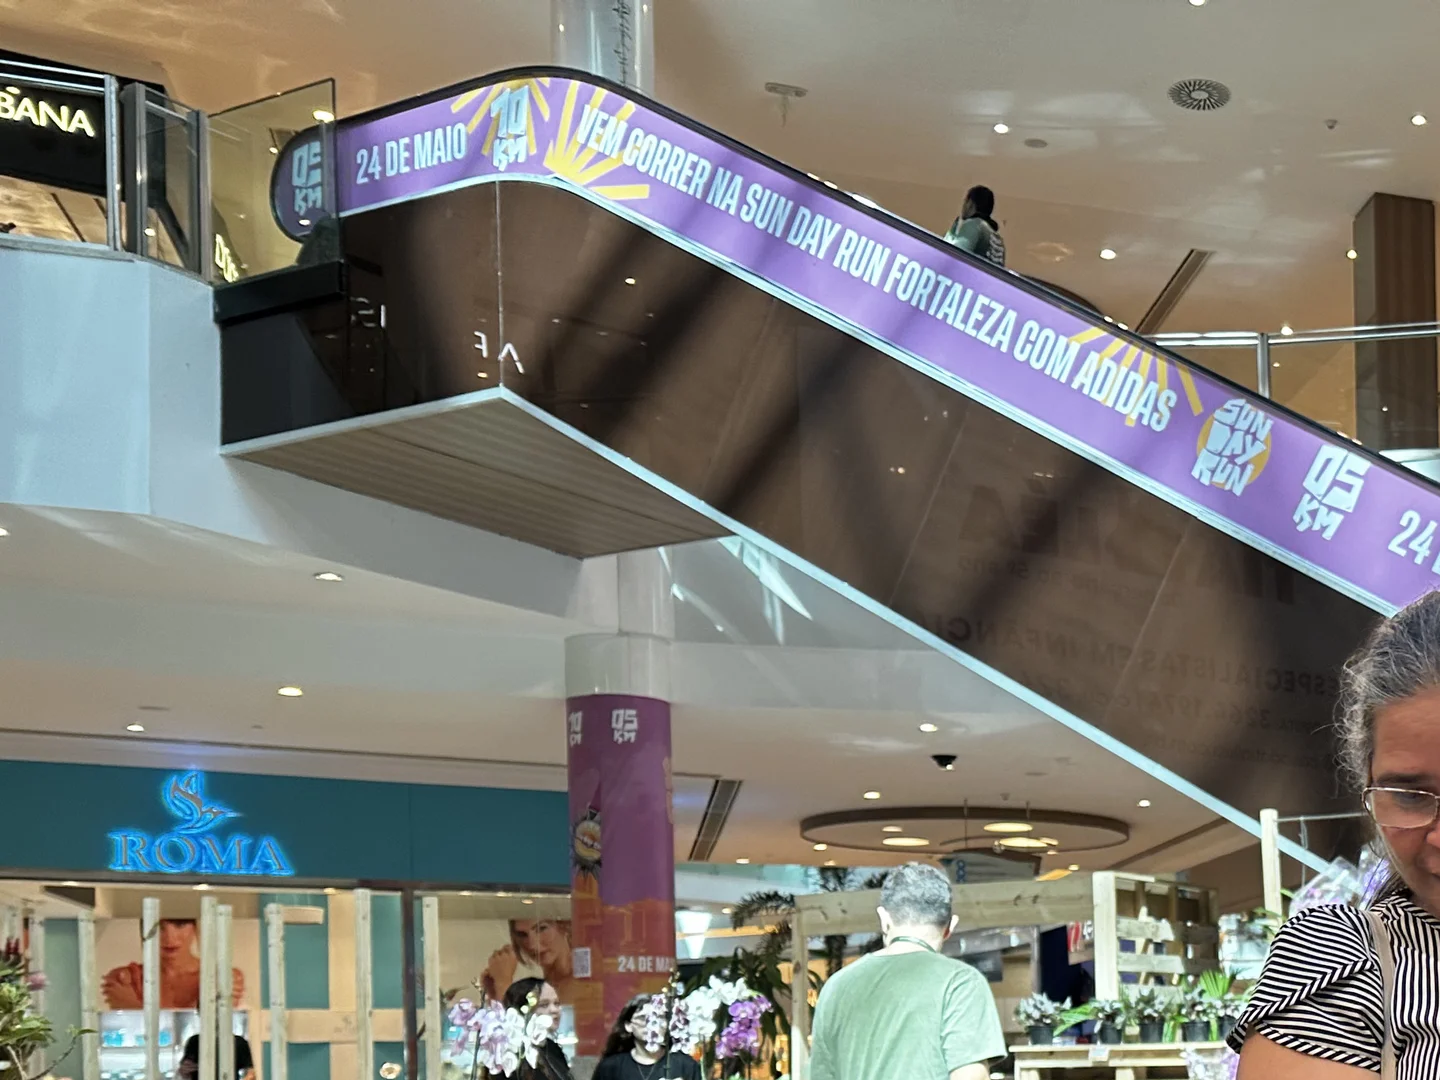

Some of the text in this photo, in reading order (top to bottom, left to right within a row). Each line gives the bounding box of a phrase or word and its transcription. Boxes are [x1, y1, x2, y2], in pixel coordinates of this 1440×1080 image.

[490, 85, 529, 138] 10
[356, 122, 468, 184] 24 DE MAIO
[493, 136, 527, 172] KM
[576, 104, 1178, 432] VEM CORRER NA SUN DAY RUN FORTALEZA COM ADIDAS
[1206, 420, 1266, 465] DAY
[1214, 398, 1274, 443] SUN
[1191, 447, 1255, 497] RUN
[1302, 444, 1372, 513] 05
[1292, 493, 1344, 540] KM
[1388, 510, 1438, 565] 24
[611, 708, 638, 731] 05
[613, 730, 636, 744] KM
[107, 829, 295, 876] ROMA
[618, 955, 635, 973] 24
[638, 955, 653, 973] DE
